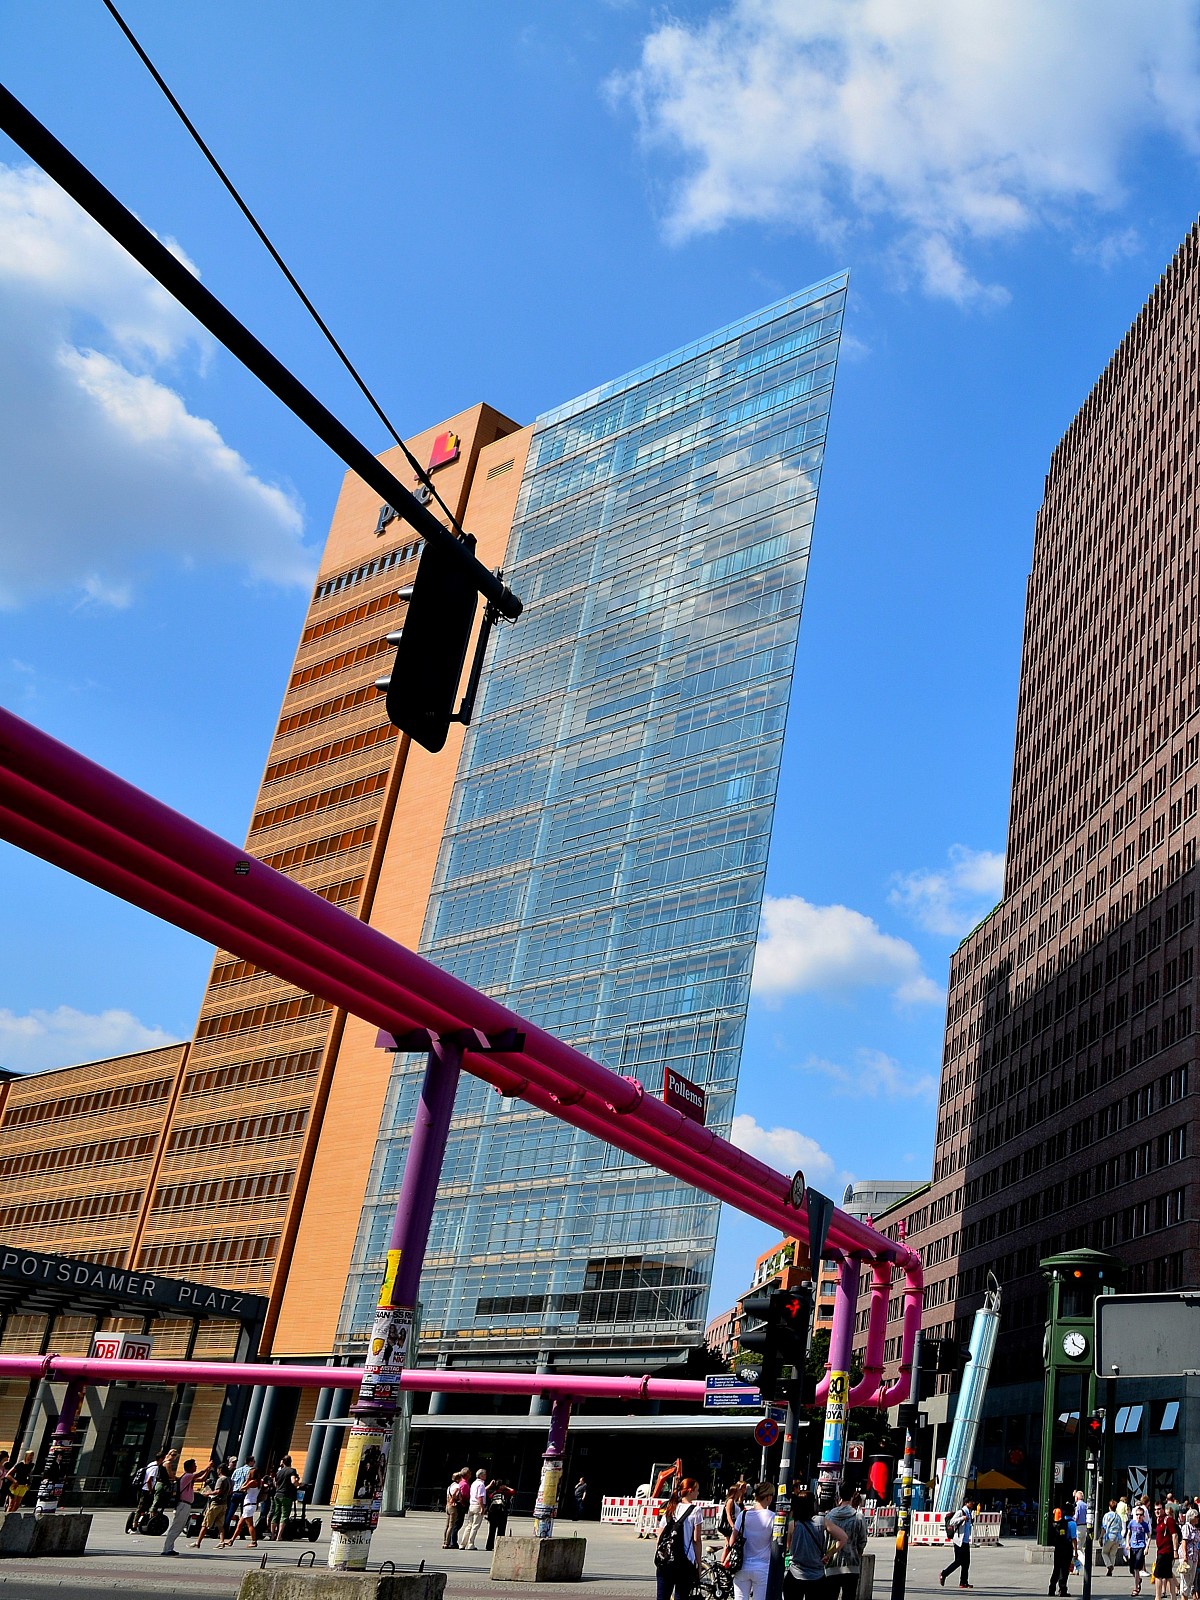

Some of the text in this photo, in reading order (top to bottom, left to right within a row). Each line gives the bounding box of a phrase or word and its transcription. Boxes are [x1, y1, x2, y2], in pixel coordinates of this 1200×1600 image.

[374, 484, 432, 534] pc
[668, 1074, 703, 1108] Pollems
[2, 1253, 244, 1313] POTSDAMER PLATZ
[94, 1343, 116, 1359] DB
[124, 1344, 146, 1360] DB
[826, 1410, 843, 1420] OYA
[339, 1535, 363, 1545] lassik
